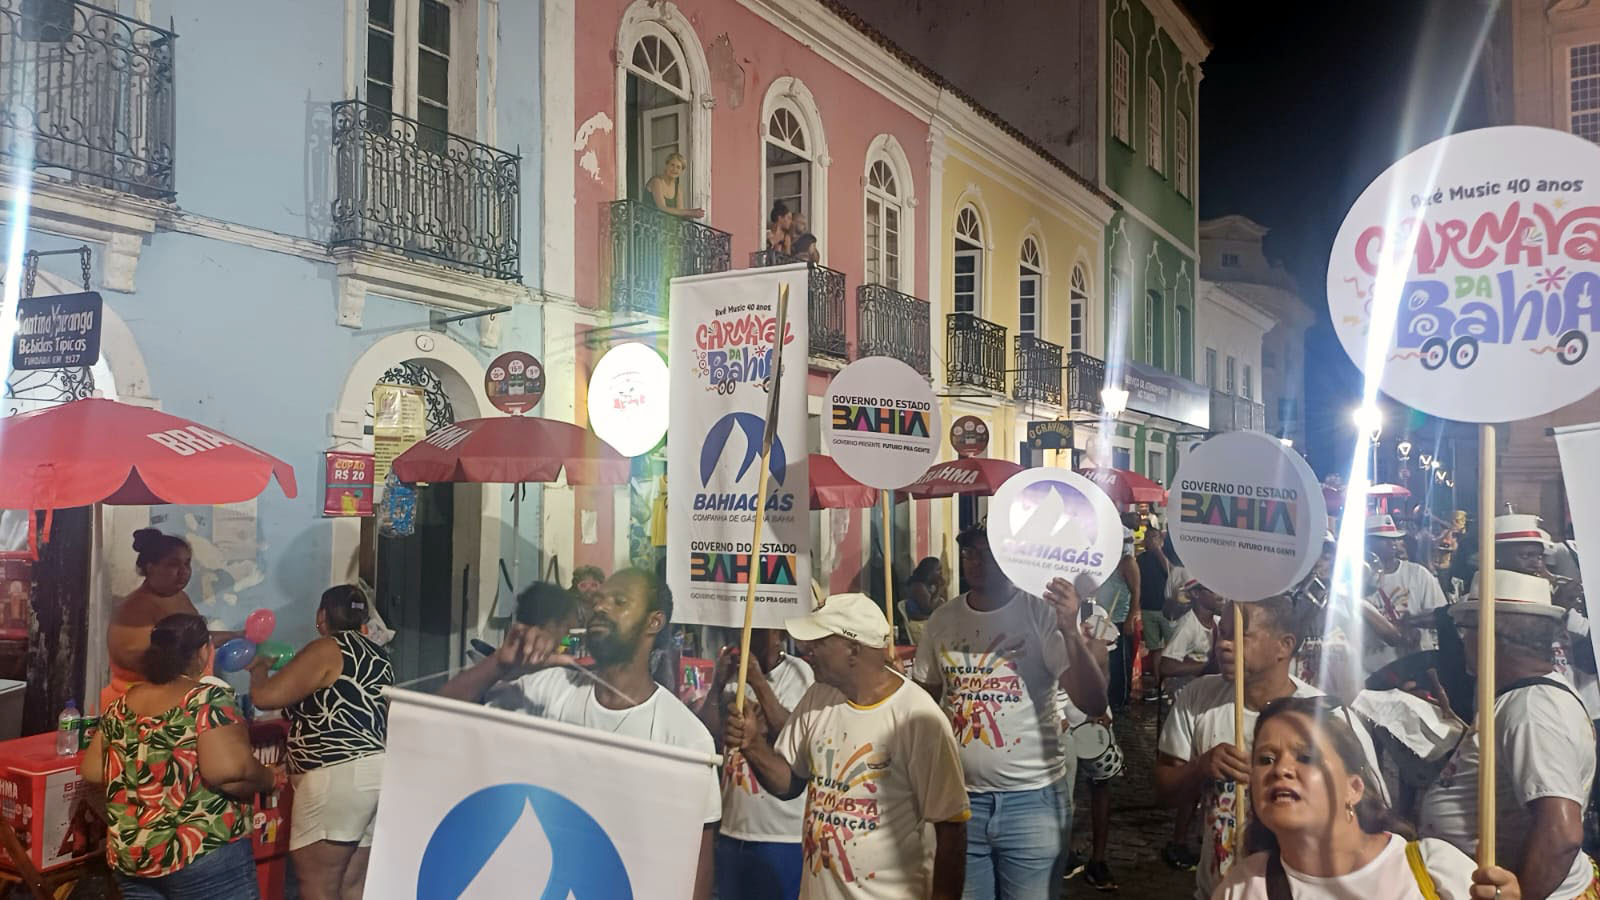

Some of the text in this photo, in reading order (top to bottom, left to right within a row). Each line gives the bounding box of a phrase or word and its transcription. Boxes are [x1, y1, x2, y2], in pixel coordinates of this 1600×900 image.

[1449, 180, 1501, 201] Music
[1506, 178, 1531, 194] 40
[1535, 178, 1584, 193] anos
[1454, 274, 1493, 299] DA
[727, 303, 746, 313] Music
[746, 303, 756, 311] 40
[756, 304, 772, 312] anos
[51, 303, 94, 337] Ypiranga
[18, 336, 53, 354] Bebidas
[728, 348, 741, 361] DA
[832, 394, 931, 411] GOVERNO DO ESTADO
[832, 404, 931, 439] BAHIA
[882, 442, 903, 451] FUTURO
[913, 446, 931, 454] GENTE
[334, 469, 365, 481] R$ 20
[1181, 479, 1298, 501] GOVERNO DO ESTADO
[693, 488, 795, 512] BAHIAGÁS
[692, 513, 729, 523] COMPANHIA
[728, 514, 739, 523] DE
[1180, 491, 1297, 537] BAHIA
[690, 541, 734, 552] GOVERNO
[736, 543, 752, 553] DO
[1180, 534, 1210, 544] GOVERNO
[1238, 541, 1263, 552] FUTURO
[1263, 545, 1275, 554] PRA
[1276, 547, 1296, 558] GENTE
[690, 552, 798, 586] BAHIA
[778, 596, 798, 604] GENTE
[842, 628, 858, 639] VOLT
[812, 810, 878, 831] TRADIÇÃO
